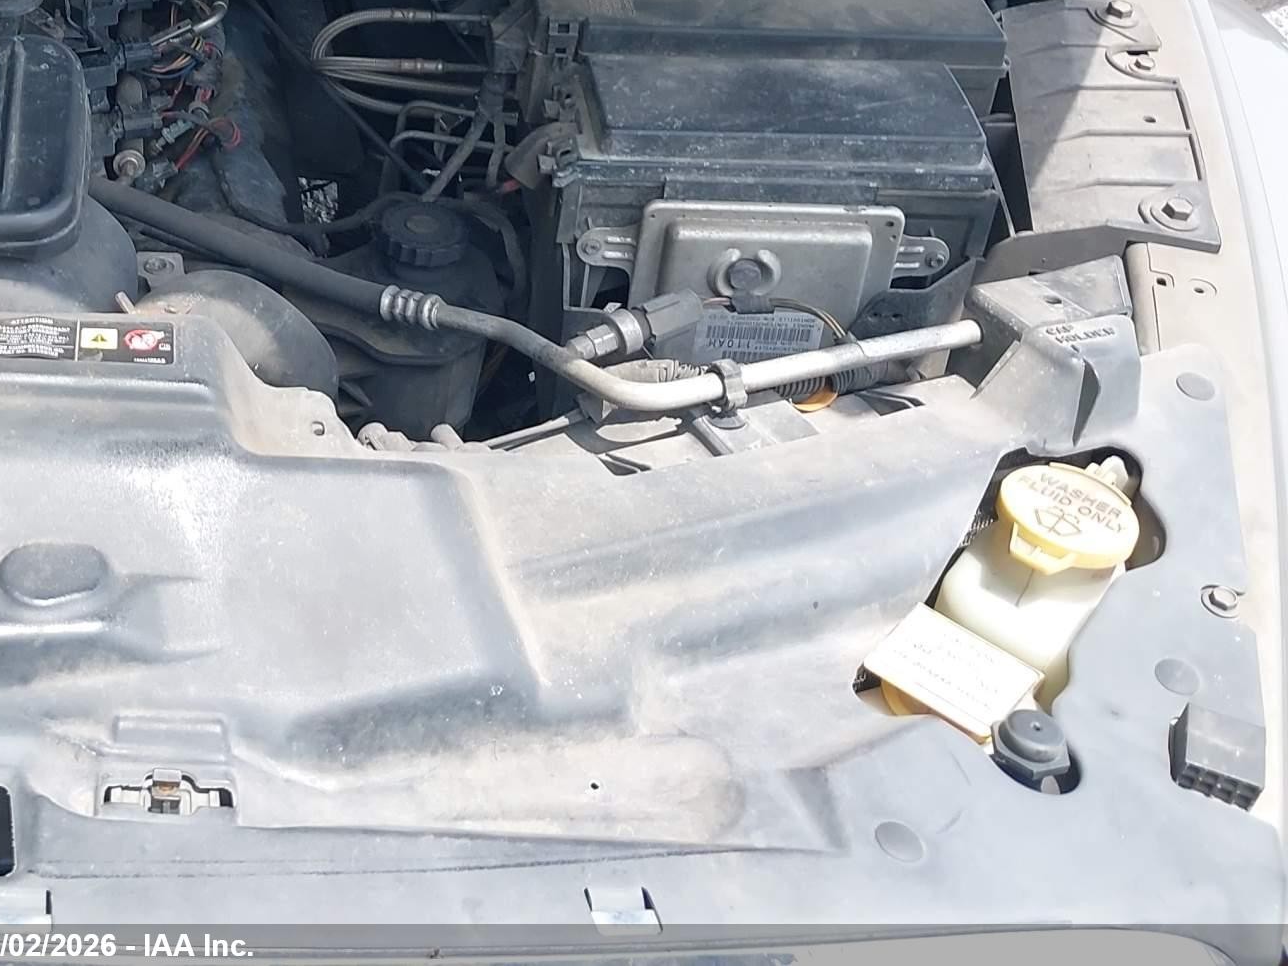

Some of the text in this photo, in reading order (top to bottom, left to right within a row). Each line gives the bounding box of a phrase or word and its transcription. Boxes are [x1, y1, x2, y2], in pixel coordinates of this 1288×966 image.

[1045, 324, 1075, 336] CAP
[1055, 326, 1116, 344] HOLDER
[1017, 474, 1128, 534] FLUID ONLY
[1040, 471, 1123, 518] WASHER
